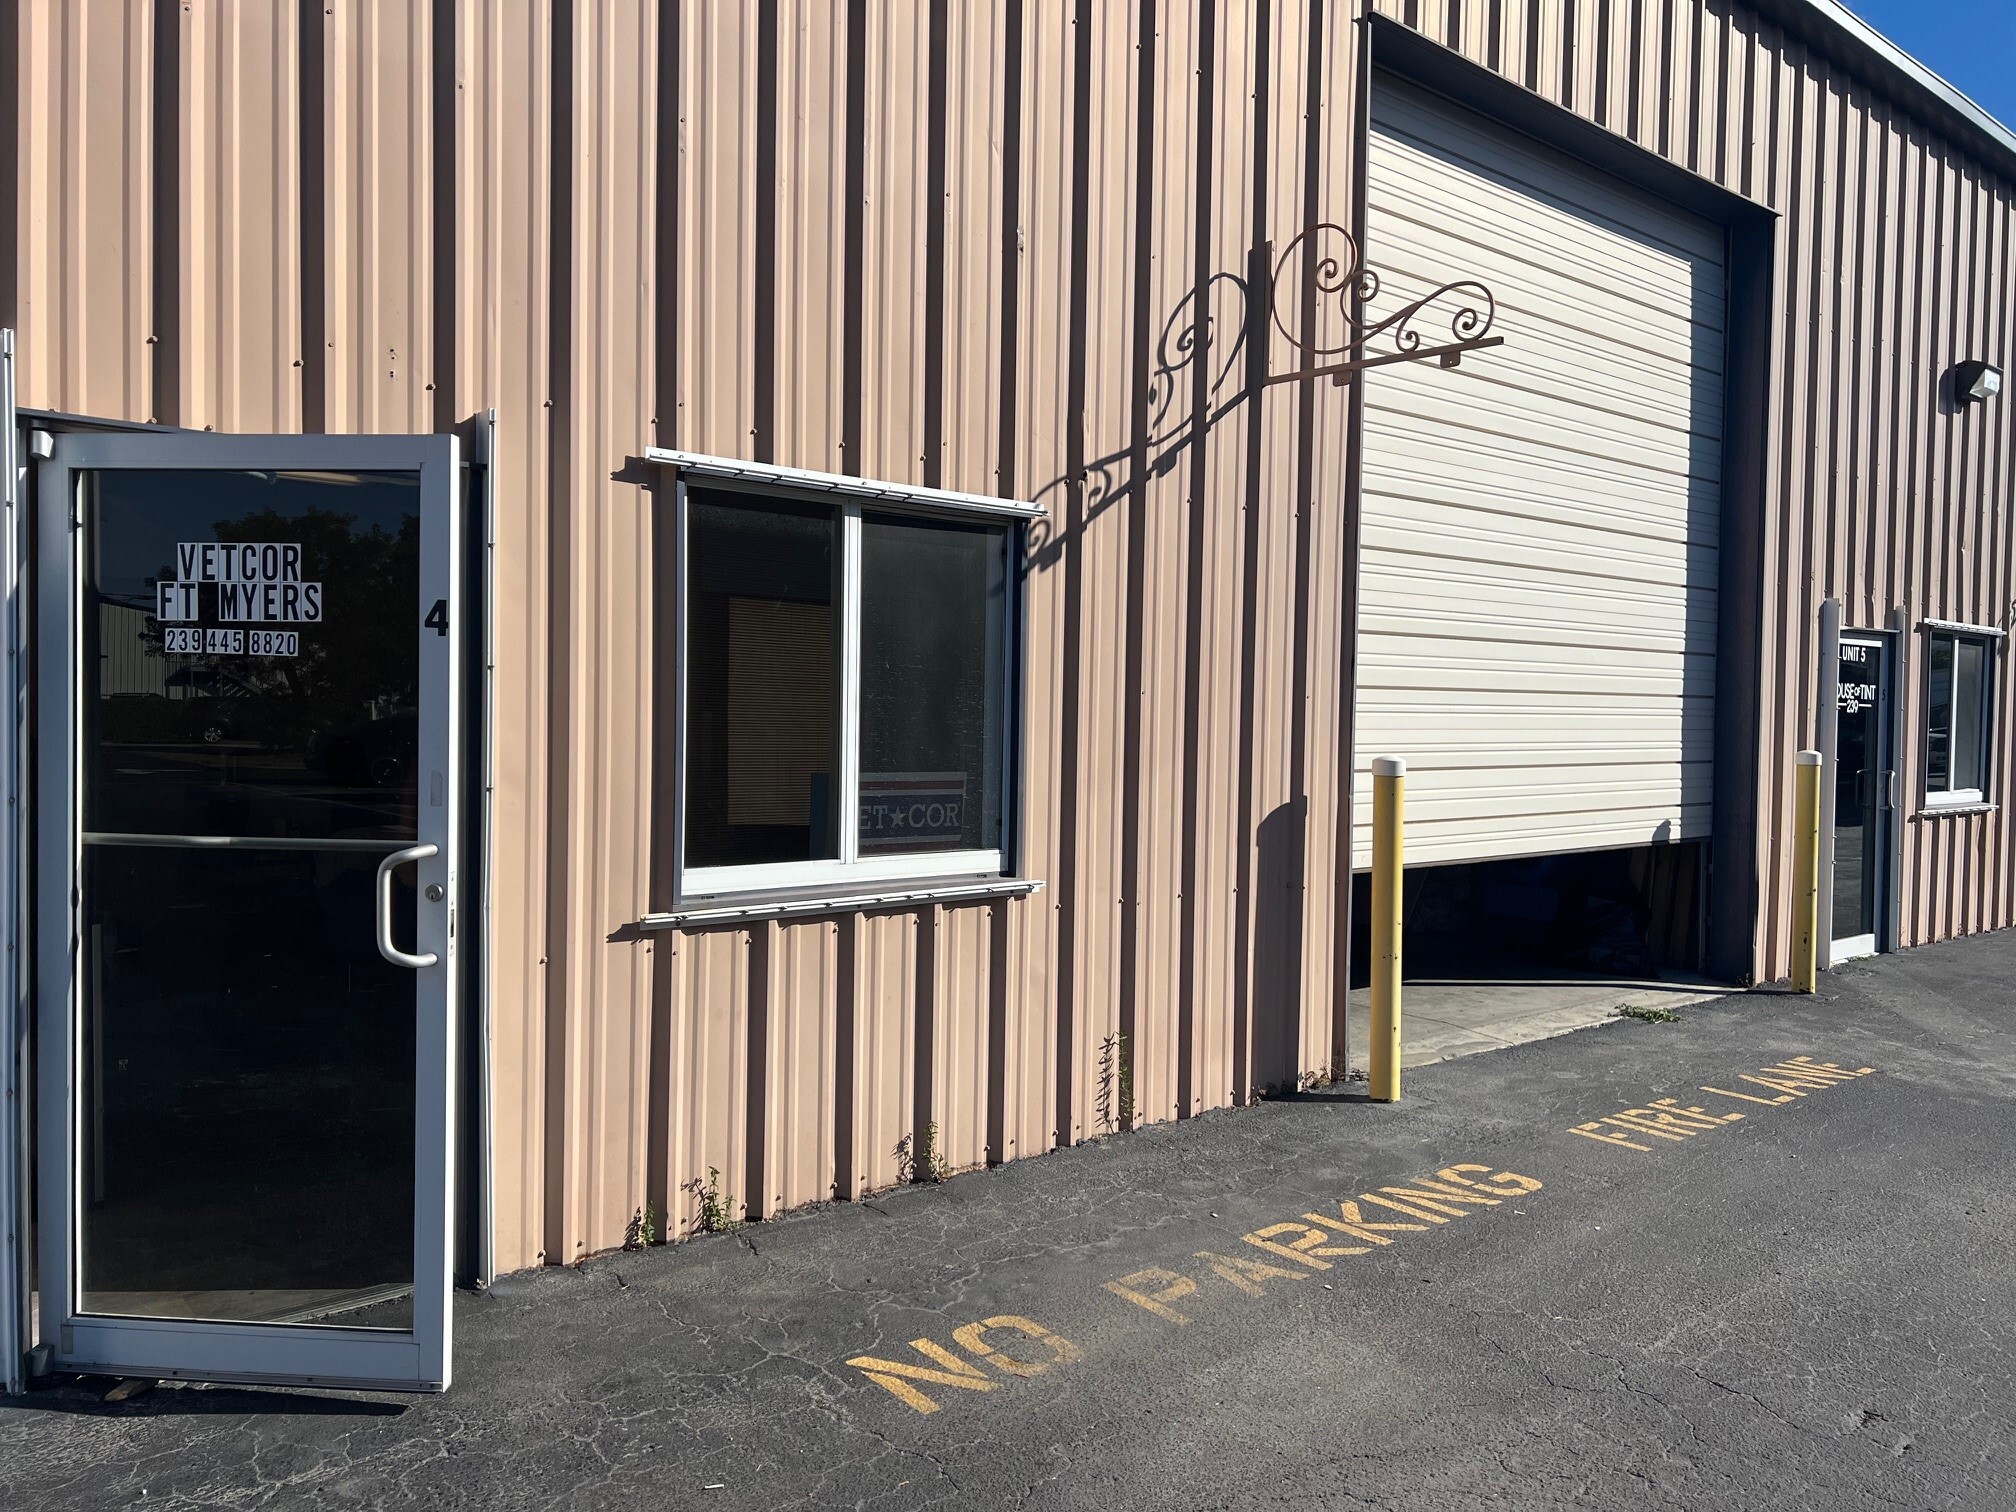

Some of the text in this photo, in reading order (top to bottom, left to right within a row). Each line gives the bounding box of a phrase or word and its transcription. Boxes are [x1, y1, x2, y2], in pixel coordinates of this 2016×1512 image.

[179, 542, 300, 582] VETCOR
[159, 582, 320, 621] FT MYERS
[425, 599, 448, 637] 4
[166, 629, 297, 655] 239 445 8820
[1842, 645, 1867, 663] UNIT 5
[1837, 682, 1855, 699] OUSE
[1846, 699, 1859, 713] 239
[859, 804, 888, 830] ET
[845, 1056, 1877, 1415] NO PARKING FIRE LANE
